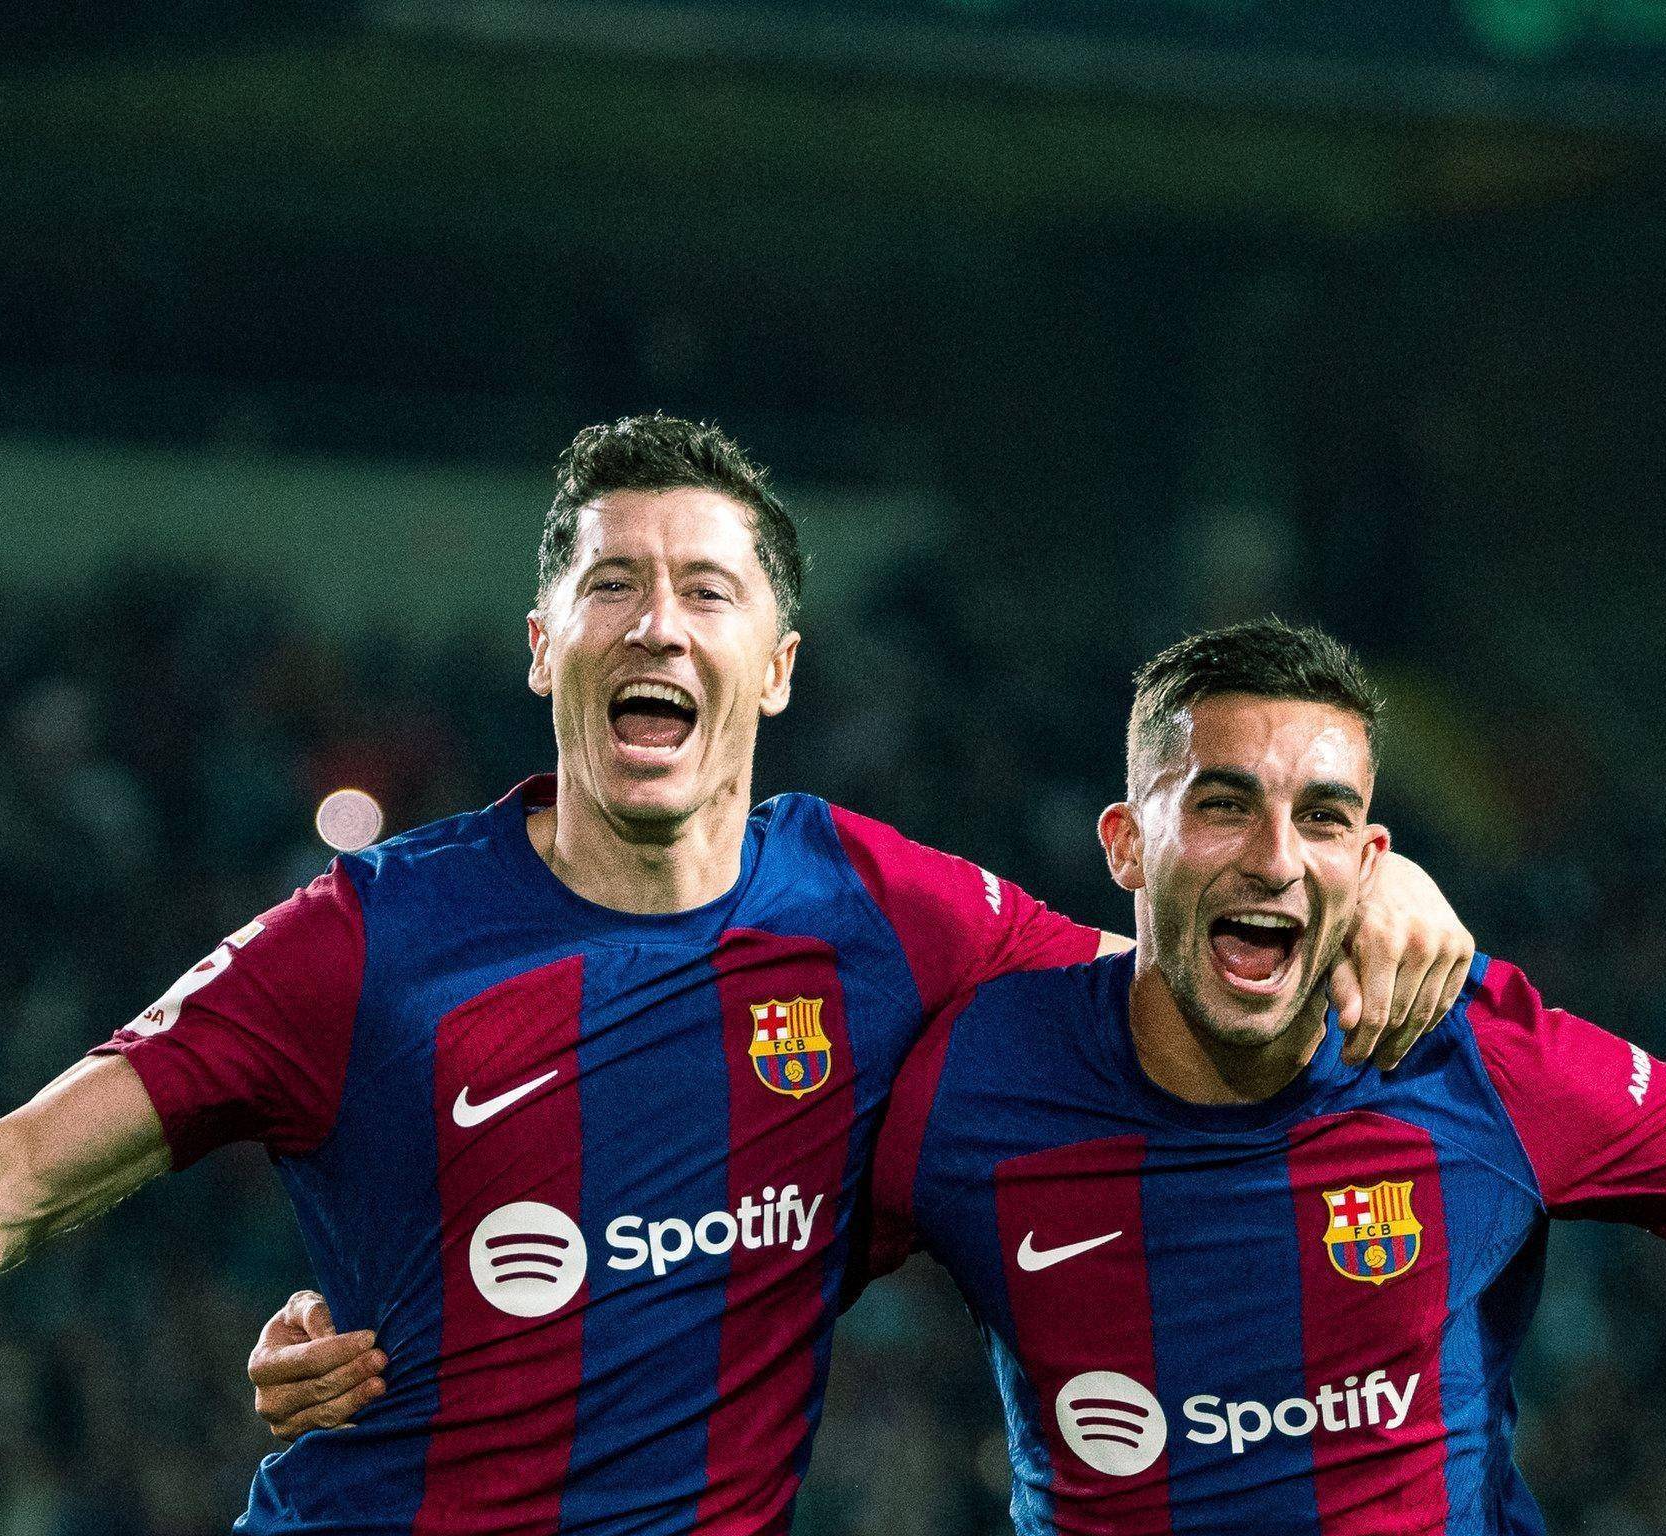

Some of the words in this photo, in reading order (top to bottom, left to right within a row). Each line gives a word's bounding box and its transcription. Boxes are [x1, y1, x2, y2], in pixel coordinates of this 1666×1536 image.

[773, 1038, 806, 1053] FCB
[605, 1184, 825, 1276] Spotify
[1353, 1223, 1392, 1239] FCB
[1182, 1369, 1421, 1454] Spotify
